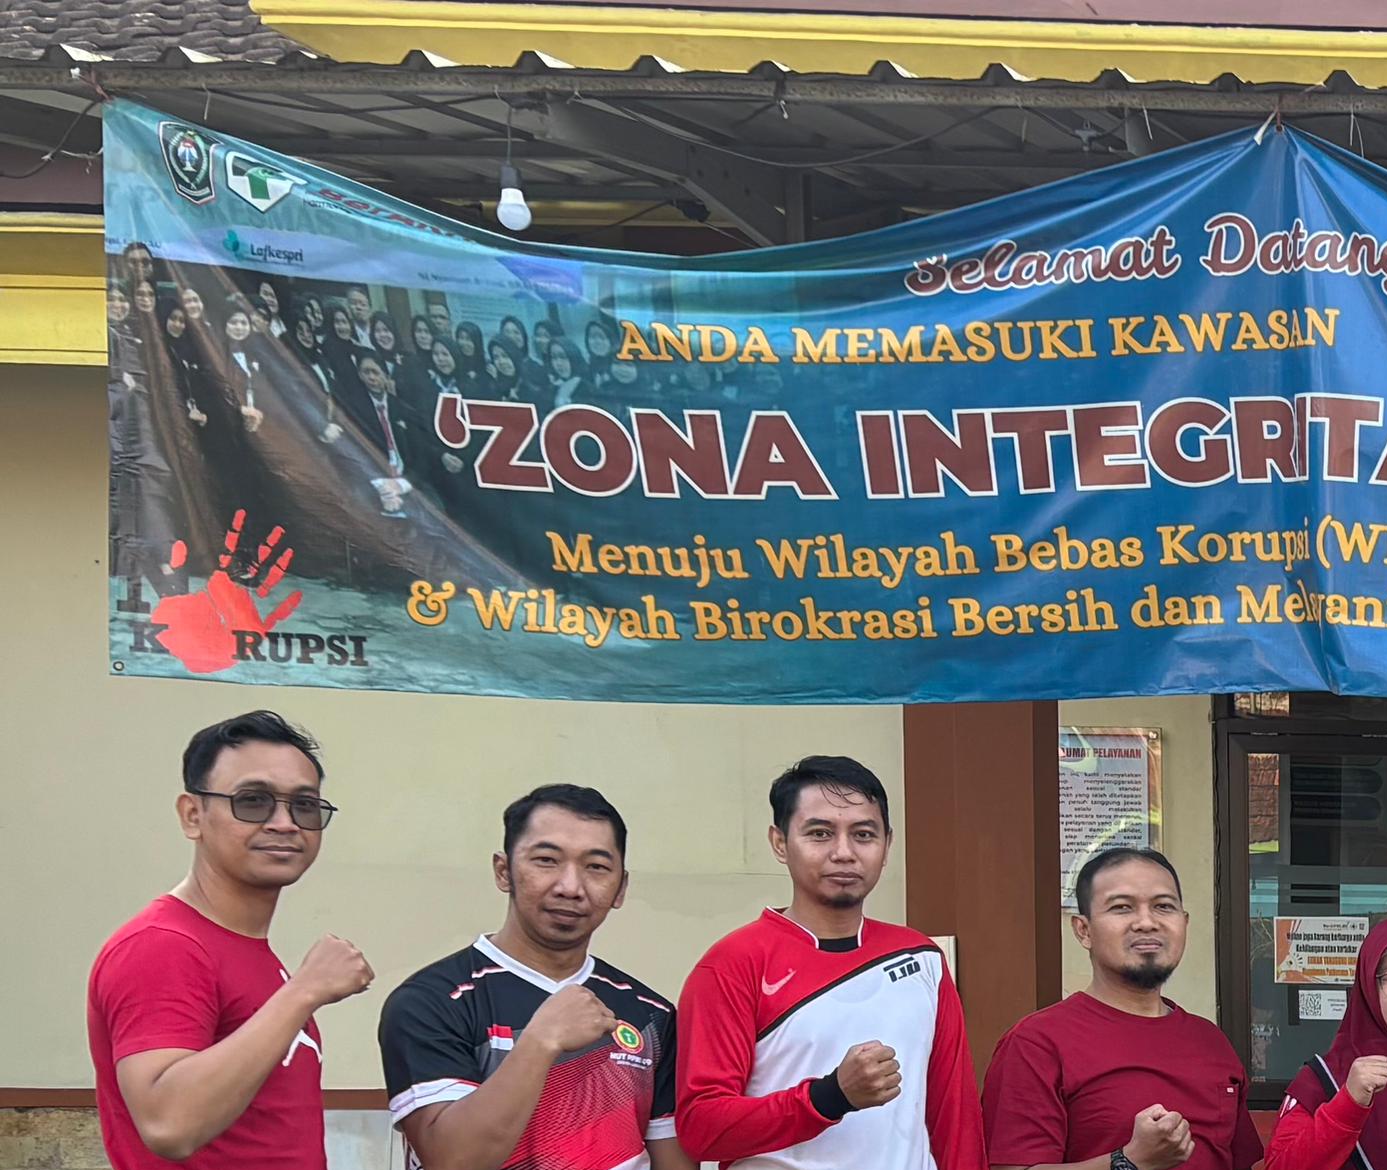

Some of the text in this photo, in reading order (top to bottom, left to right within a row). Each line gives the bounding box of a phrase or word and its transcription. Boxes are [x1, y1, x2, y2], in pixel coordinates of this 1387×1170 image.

[904, 224, 1182, 297] Selamat
[617, 307, 1340, 365] ANDA MEMASUKI KAWASAN
[546, 531, 744, 587] Menuju
[756, 532, 981, 588] Wilayah
[991, 526, 1143, 573] Bebas
[1156, 516, 1311, 572] Korupsi
[407, 580, 456, 627] &
[468, 587, 681, 648] Wilayah
[692, 594, 934, 642] Birokrasi
[947, 588, 1117, 639] Bersih
[1131, 584, 1223, 628] dan
